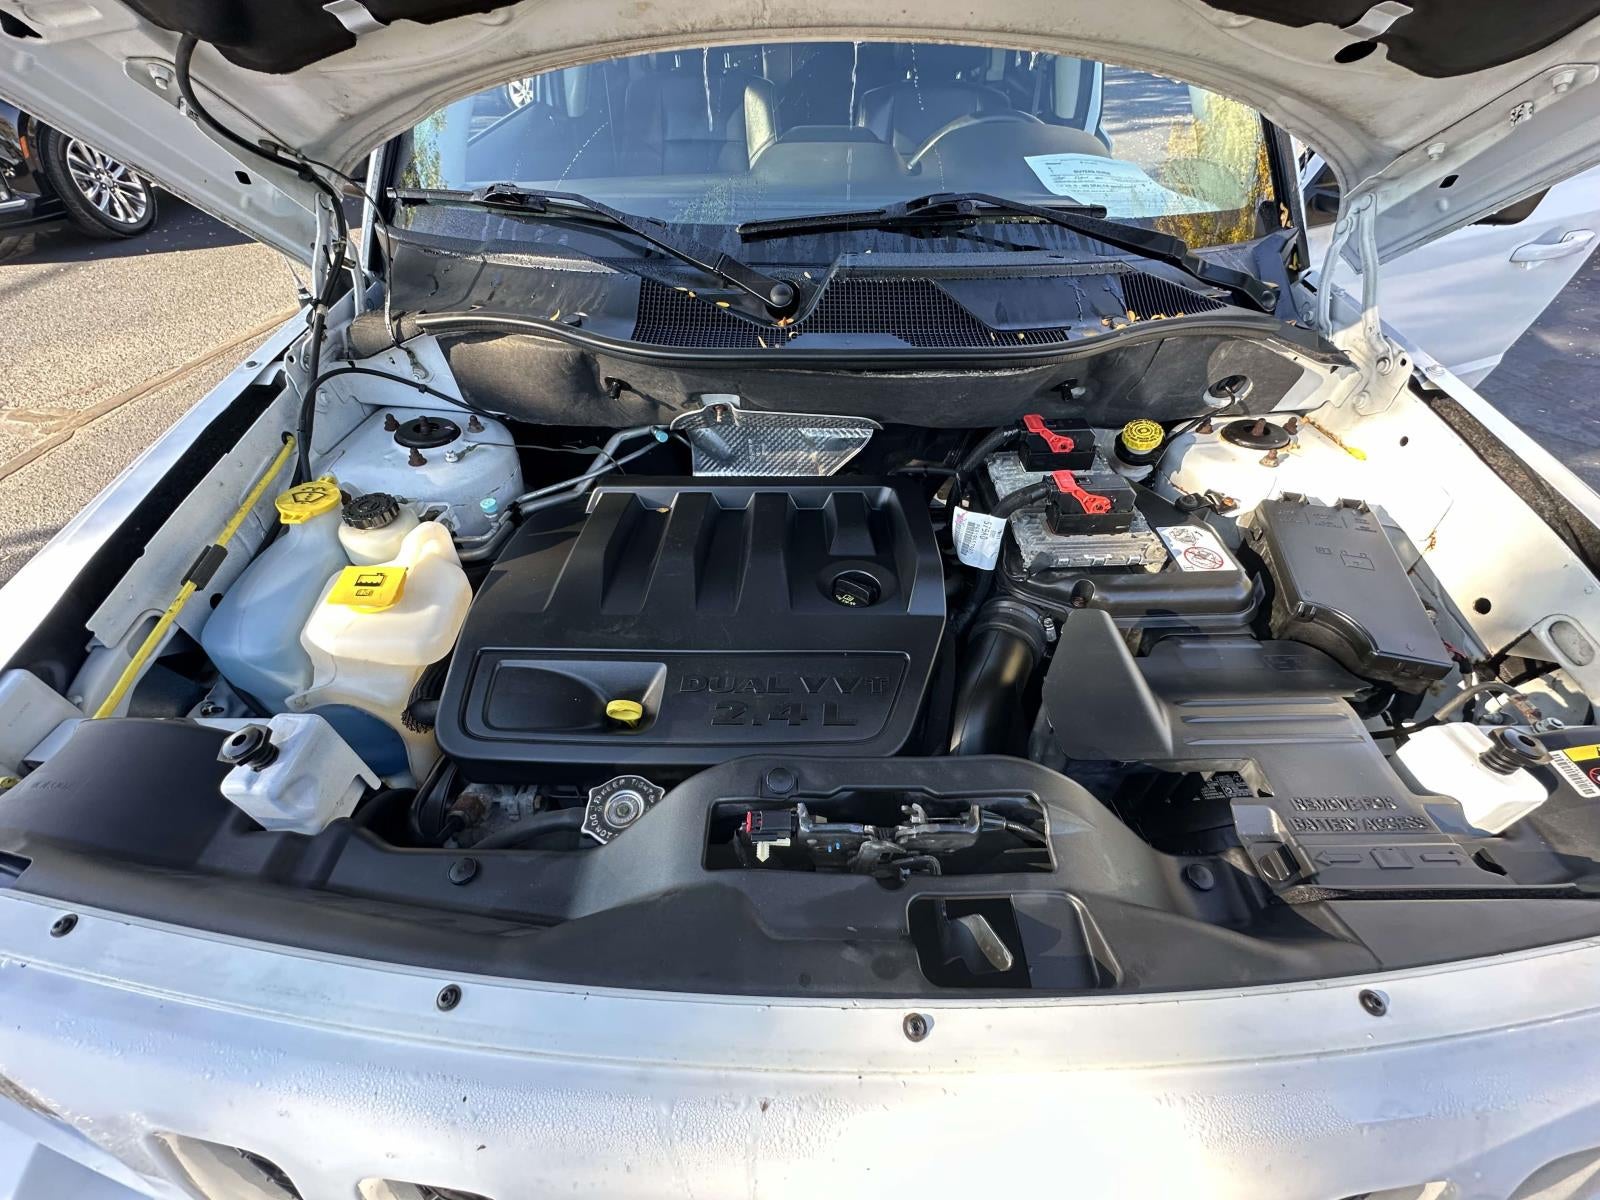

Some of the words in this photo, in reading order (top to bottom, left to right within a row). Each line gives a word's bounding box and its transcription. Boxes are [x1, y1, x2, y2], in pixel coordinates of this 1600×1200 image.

[679, 674, 792, 694] DUAL
[710, 702, 858, 727] 2.4L
[1290, 797, 1360, 812] REMOVE
[1361, 797, 1398, 811] FOR
[1288, 816, 1360, 832] BATTERY
[1361, 816, 1429, 832] ACCESS
